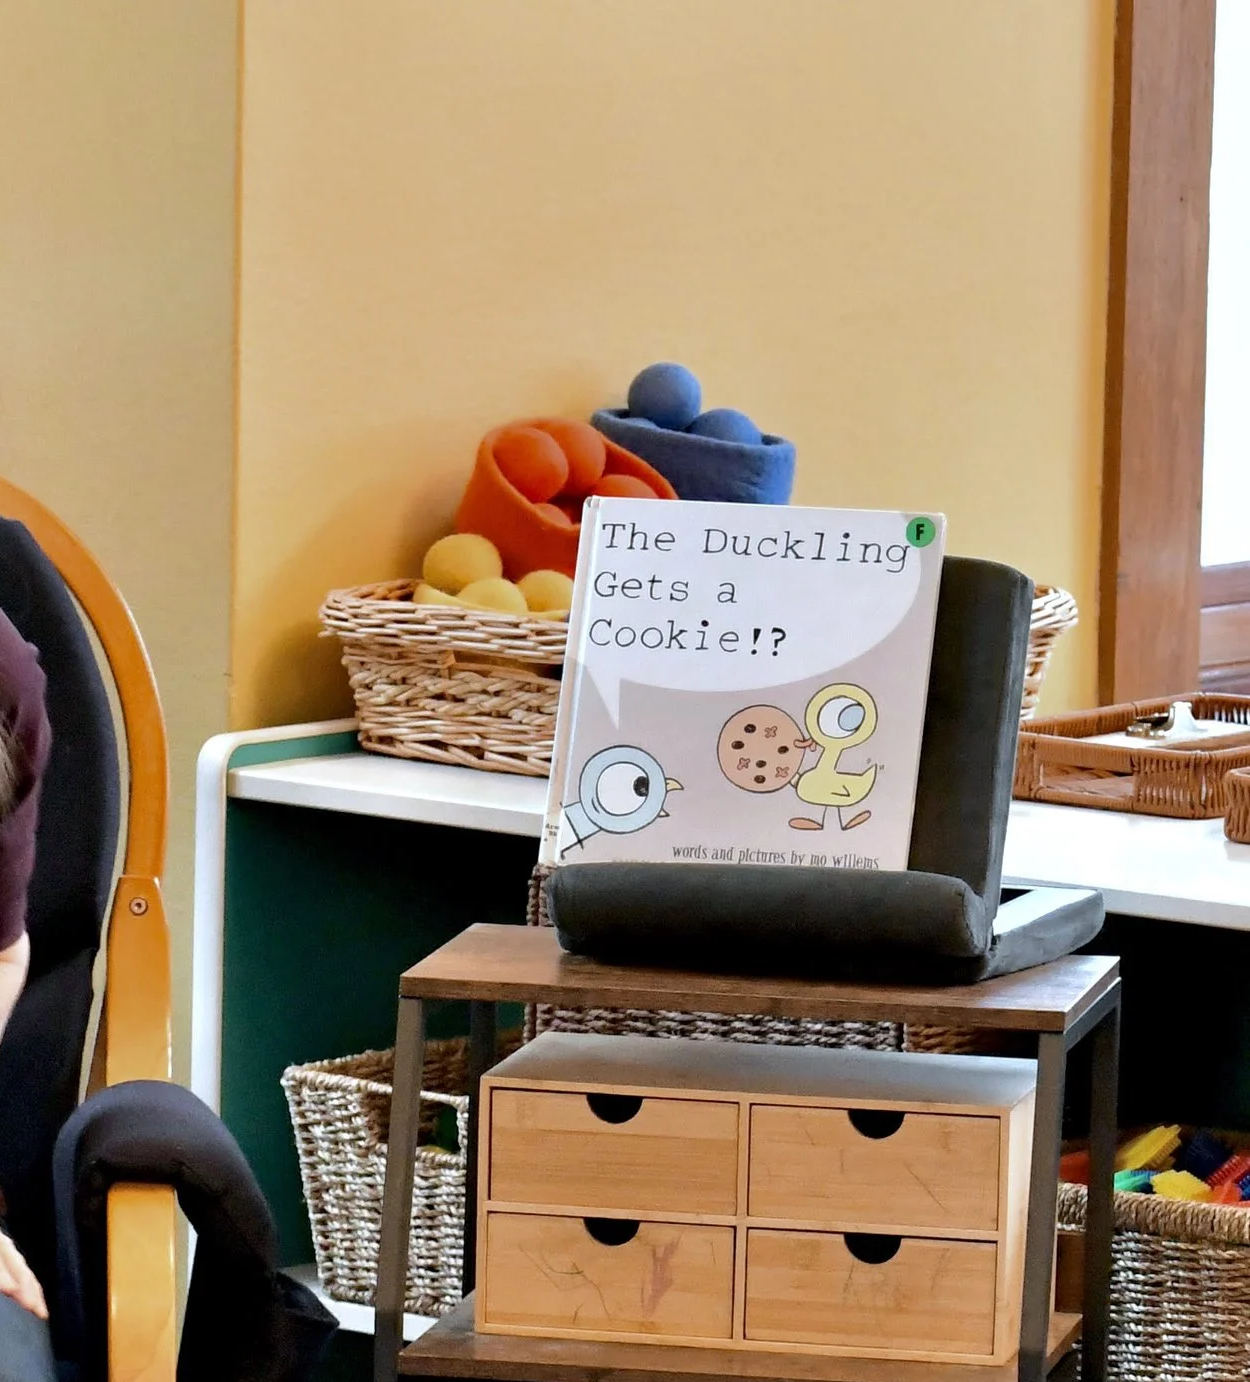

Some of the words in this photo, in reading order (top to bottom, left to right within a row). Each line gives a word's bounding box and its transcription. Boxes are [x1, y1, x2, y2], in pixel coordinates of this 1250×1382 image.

[602, 522, 677, 553] The
[702, 527, 911, 574] Duckling
[914, 523, 926, 541] F
[593, 571, 690, 603] Gets
[717, 581, 738, 604] a
[588, 618, 788, 657] Cookie!?
[672, 844, 708, 860] words
[711, 846, 734, 862] and
[738, 848, 787, 865] pictures
[790, 850, 806, 866] by
[810, 852, 827, 866] mo
[832, 853, 880, 869] willems
